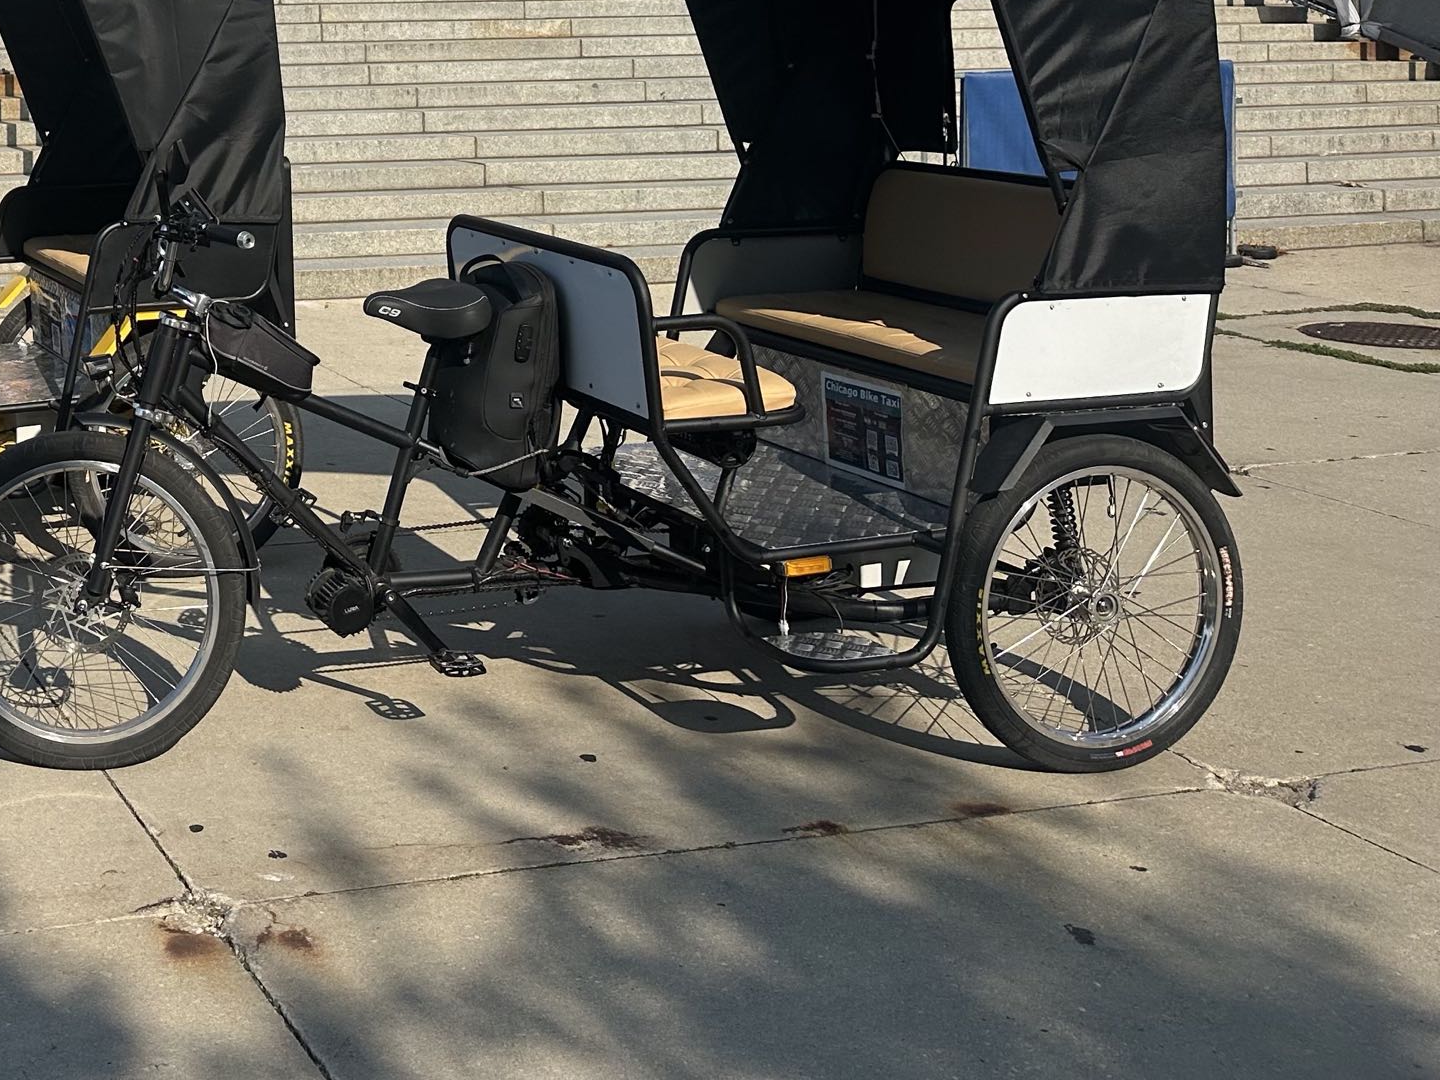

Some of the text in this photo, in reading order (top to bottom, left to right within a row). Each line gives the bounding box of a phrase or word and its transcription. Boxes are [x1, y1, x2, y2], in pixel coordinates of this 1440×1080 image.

[378, 305, 401, 317] C9
[826, 381, 900, 408] Chicago Bike Taxi
